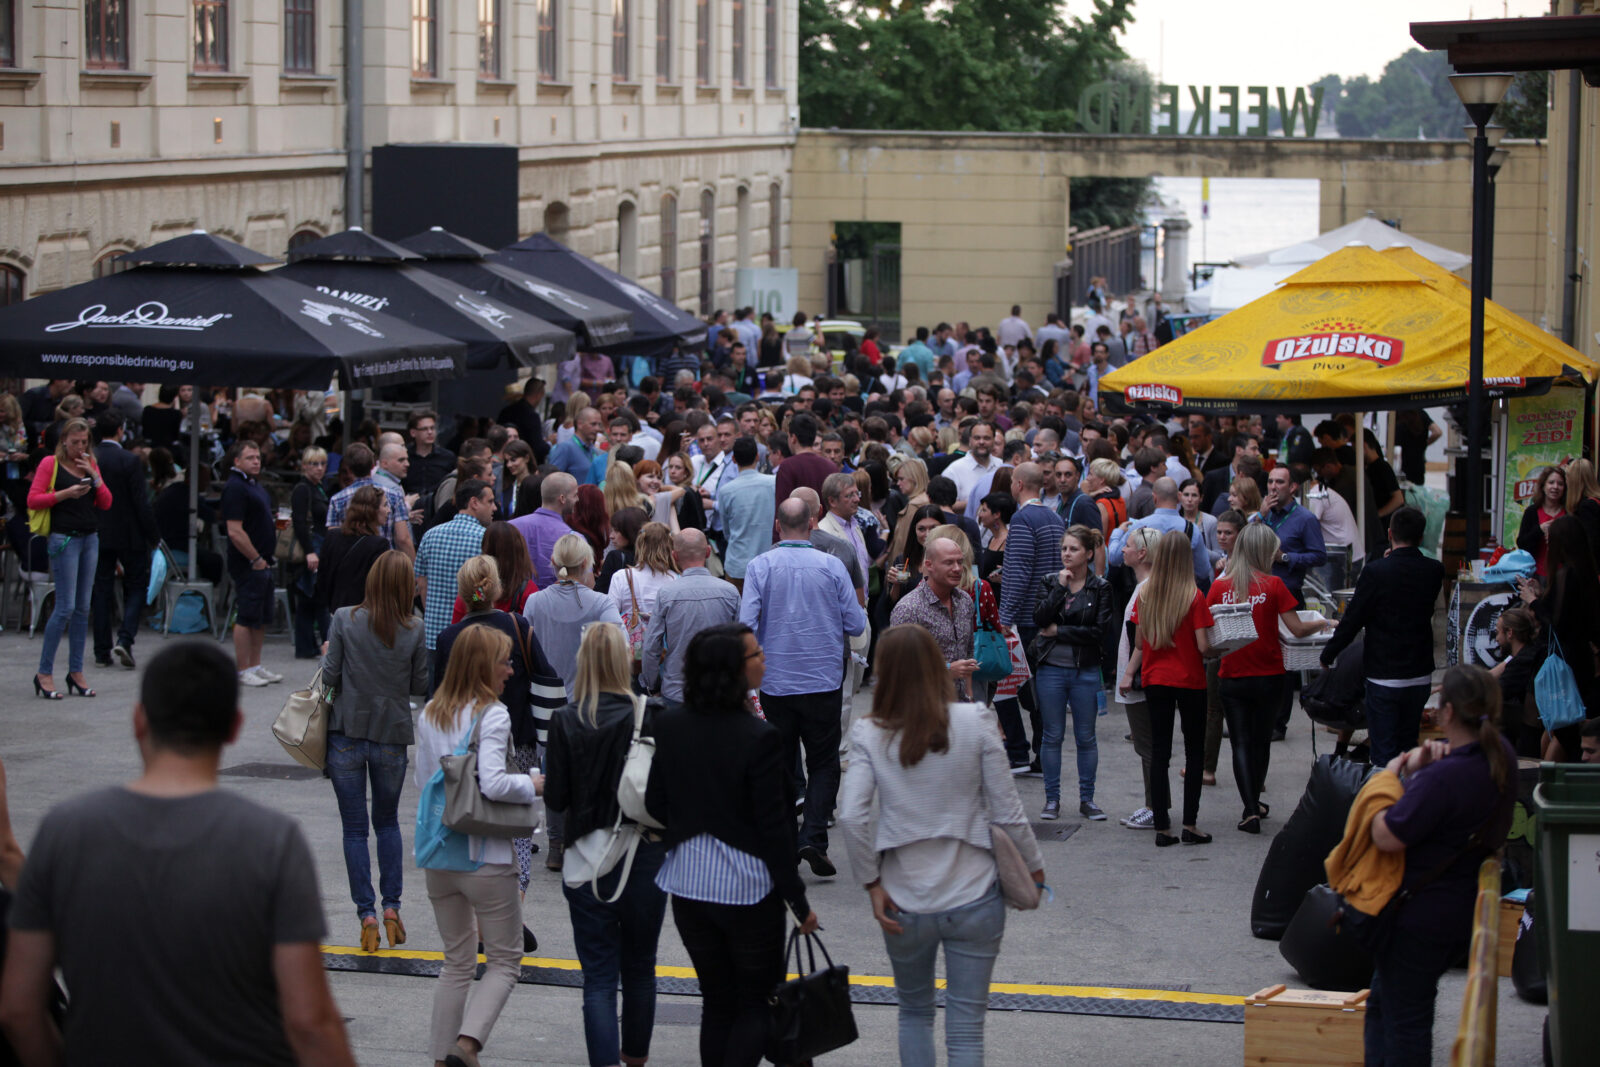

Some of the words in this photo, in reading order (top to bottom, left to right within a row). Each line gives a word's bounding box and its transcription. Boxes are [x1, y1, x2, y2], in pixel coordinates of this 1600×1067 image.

[45, 304, 137, 332] Jack
[1274, 333, 1393, 362] Ožujsko
[41, 353, 194, 371] www.responsibledrinking.eu
[1128, 384, 1178, 402] Ožujsko
